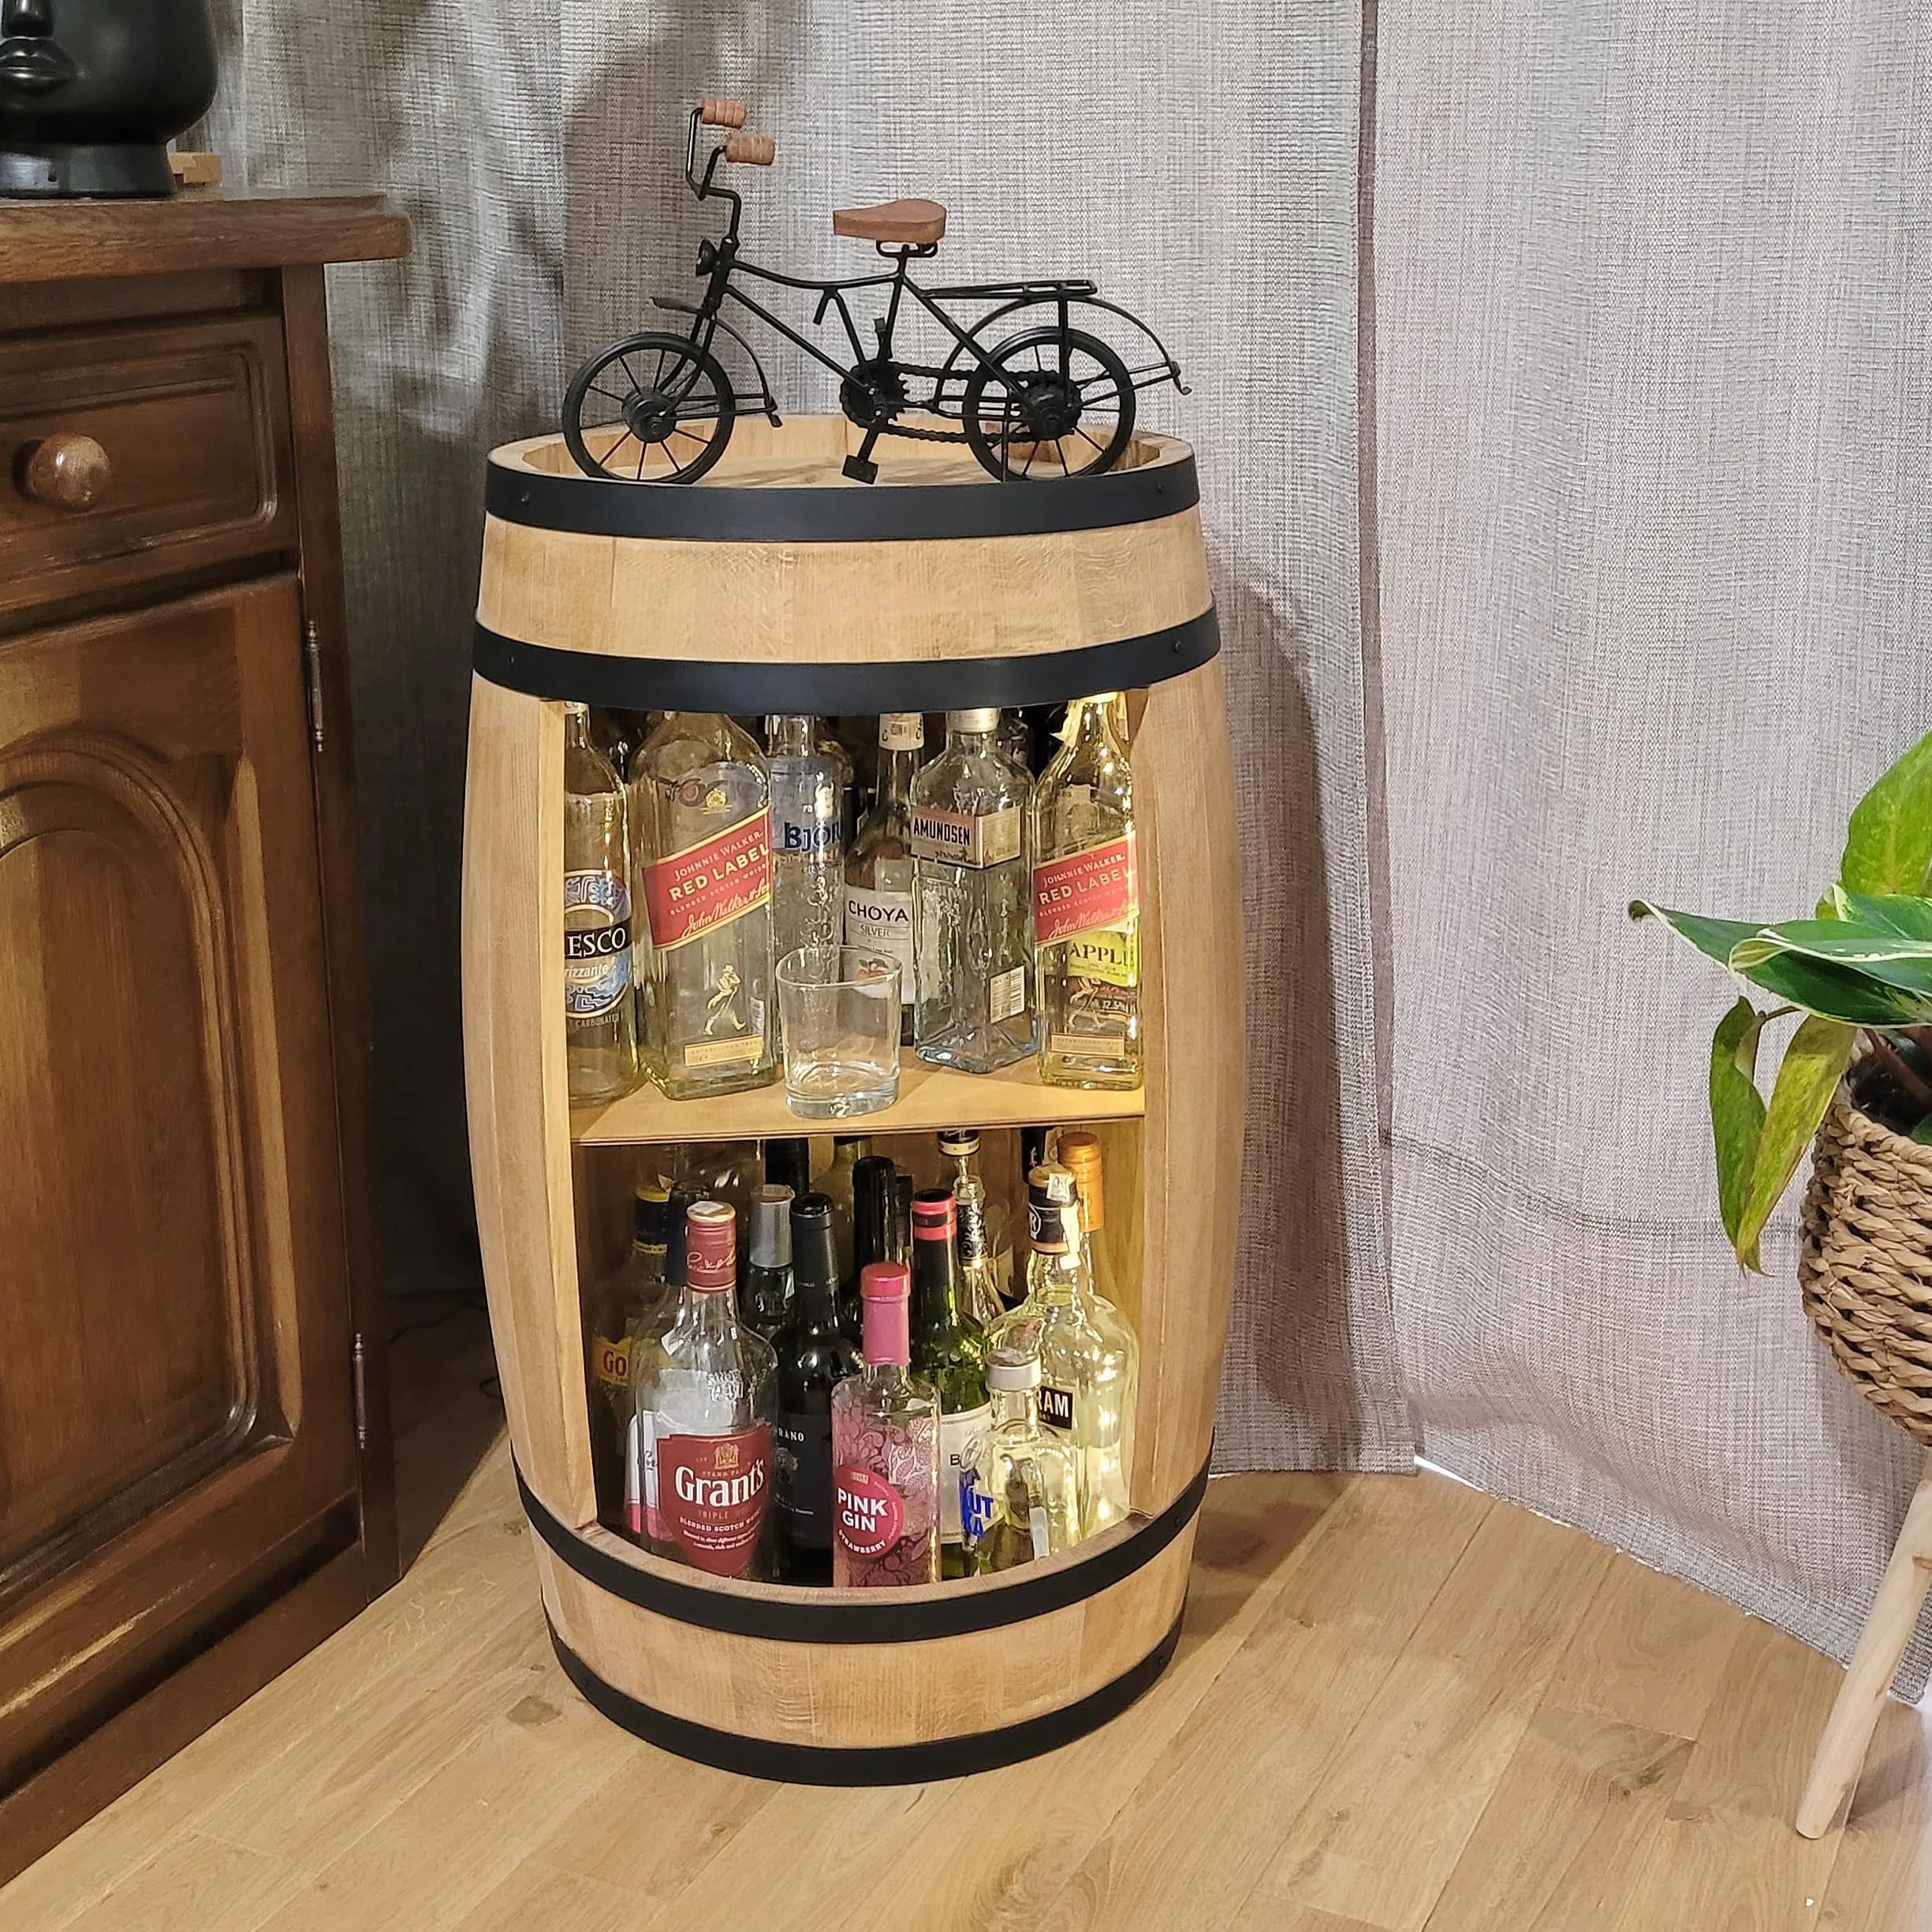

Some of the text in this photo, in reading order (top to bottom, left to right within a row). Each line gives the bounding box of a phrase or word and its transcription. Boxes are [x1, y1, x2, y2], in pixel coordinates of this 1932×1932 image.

[914, 817, 971, 846] AMUNDSEN
[669, 842, 770, 902] RED LABEL
[674, 852, 720, 882] JOHNNIE
[1043, 867, 1084, 888] JOHNNIE
[1039, 885, 1072, 905] RED
[1076, 865, 1136, 893] LABEL
[681, 910, 714, 939] John
[849, 900, 909, 923] CHOYA
[566, 927, 627, 957] ESCO
[860, 923, 890, 938] SILVER
[1048, 916, 1077, 941] John
[565, 963, 610, 979] rizzante
[603, 1349, 628, 1377] GO
[1035, 1388, 1070, 1419] RAM
[774, 1426, 804, 1442] RANO
[675, 1457, 766, 1508] Grant's
[837, 1486, 888, 1516] PINK
[971, 1489, 994, 1520] UT
[679, 1516, 712, 1531] BLENDED
[714, 1521, 744, 1532] SCOTCH
[842, 1510, 876, 1533] GIN
[838, 1528, 886, 1554] STRAWBERRY
